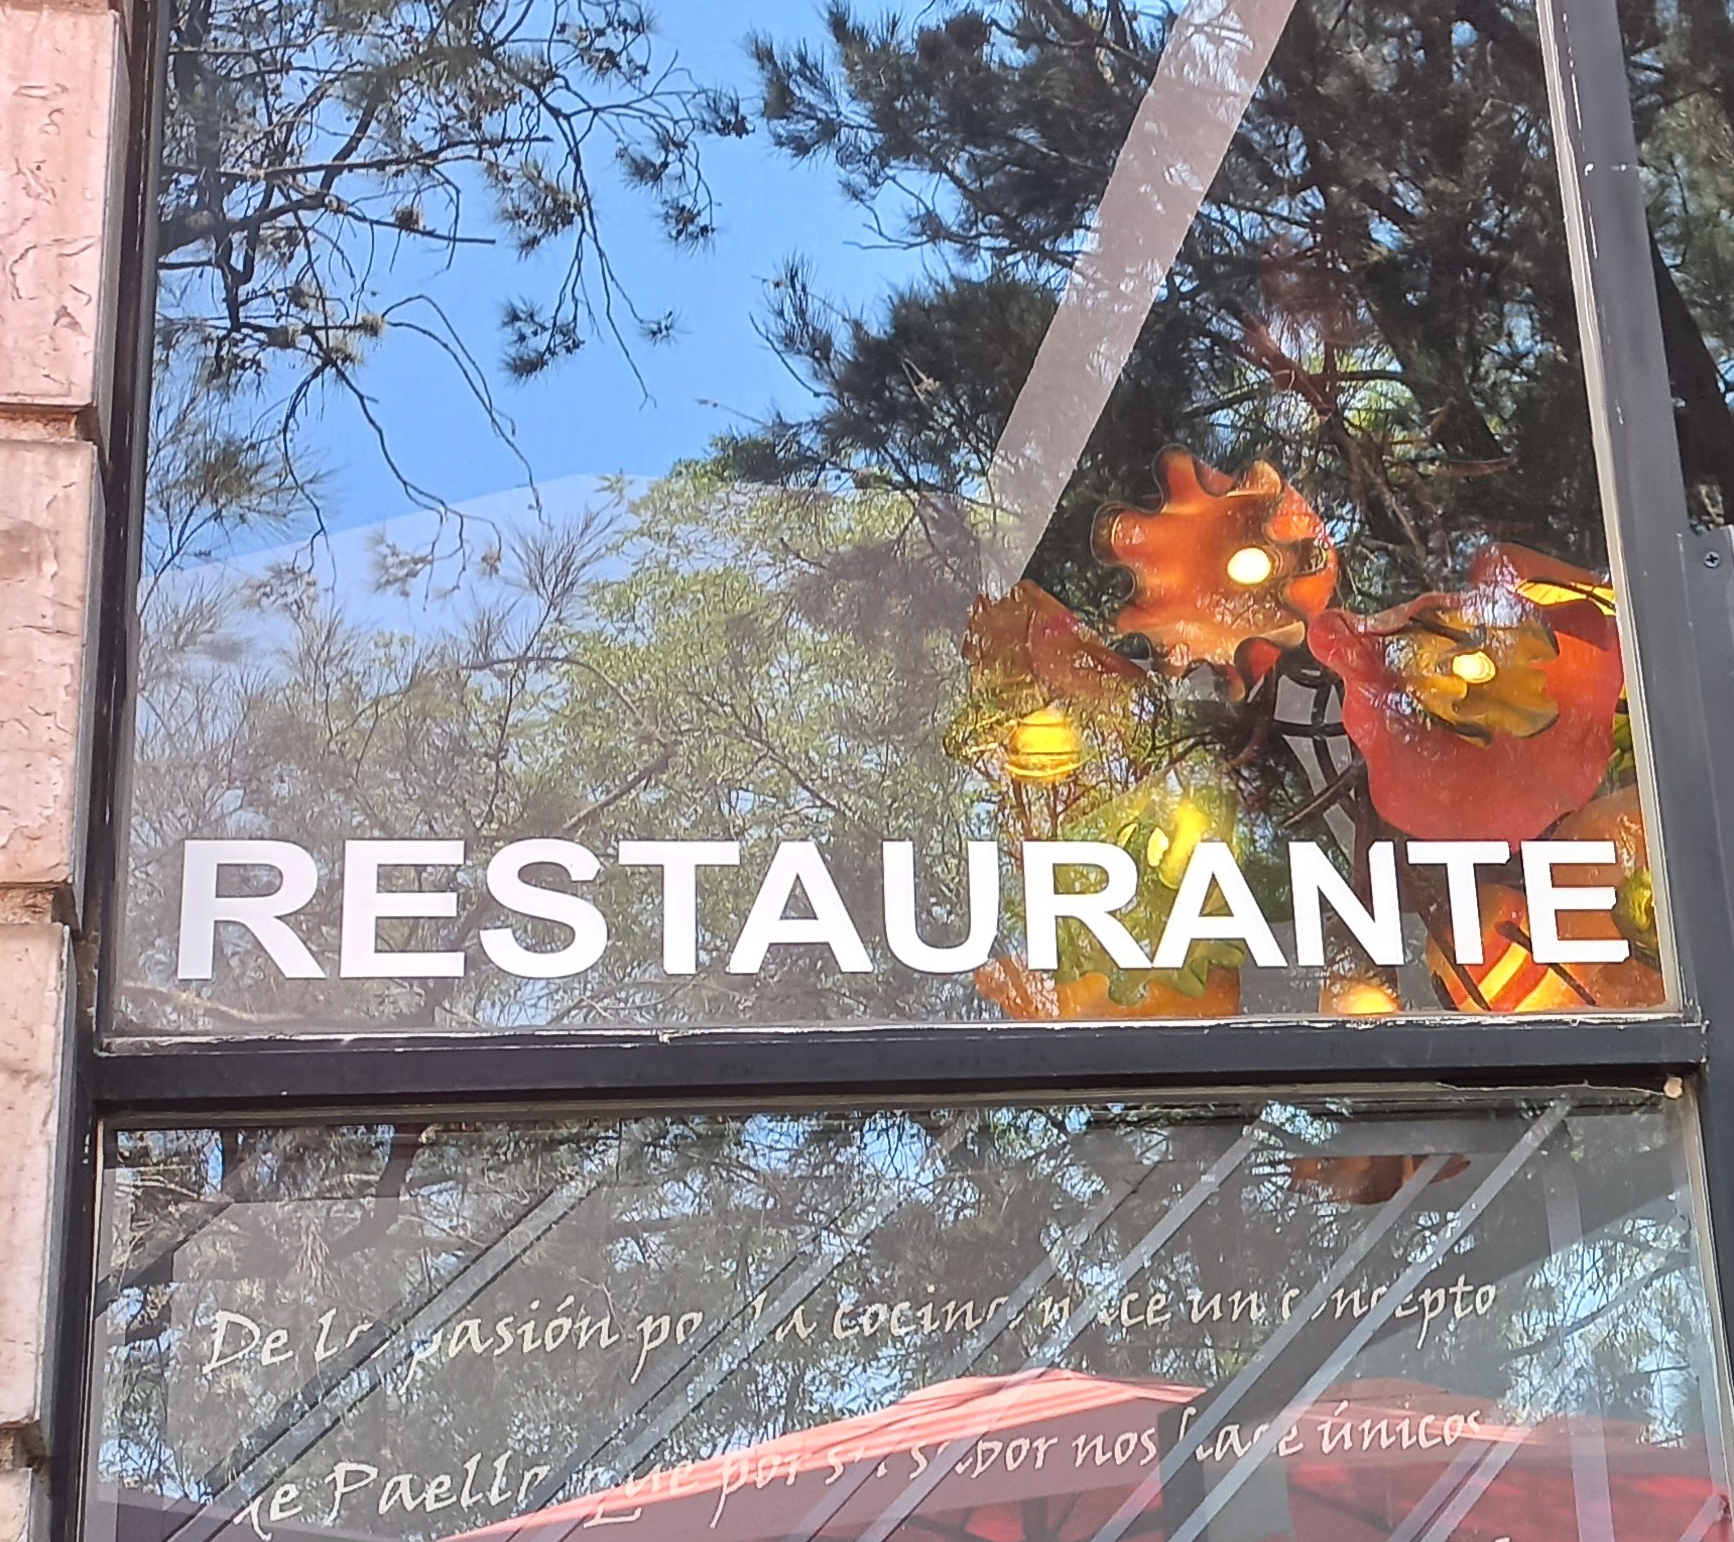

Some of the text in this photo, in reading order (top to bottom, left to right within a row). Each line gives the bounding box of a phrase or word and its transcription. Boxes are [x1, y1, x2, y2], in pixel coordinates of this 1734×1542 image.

[178, 837, 1630, 981] RESTAURANTE
[202, 1310, 293, 1374] De
[400, 1295, 619, 1395] pasión
[631, 1310, 722, 1385] po
[1041, 1289, 1172, 1328] nce
[1188, 1287, 1262, 1323] un
[1282, 1273, 1497, 1350] cnpto
[910, 1429, 1058, 1481] sbor
[1073, 1427, 1157, 1468] nos
